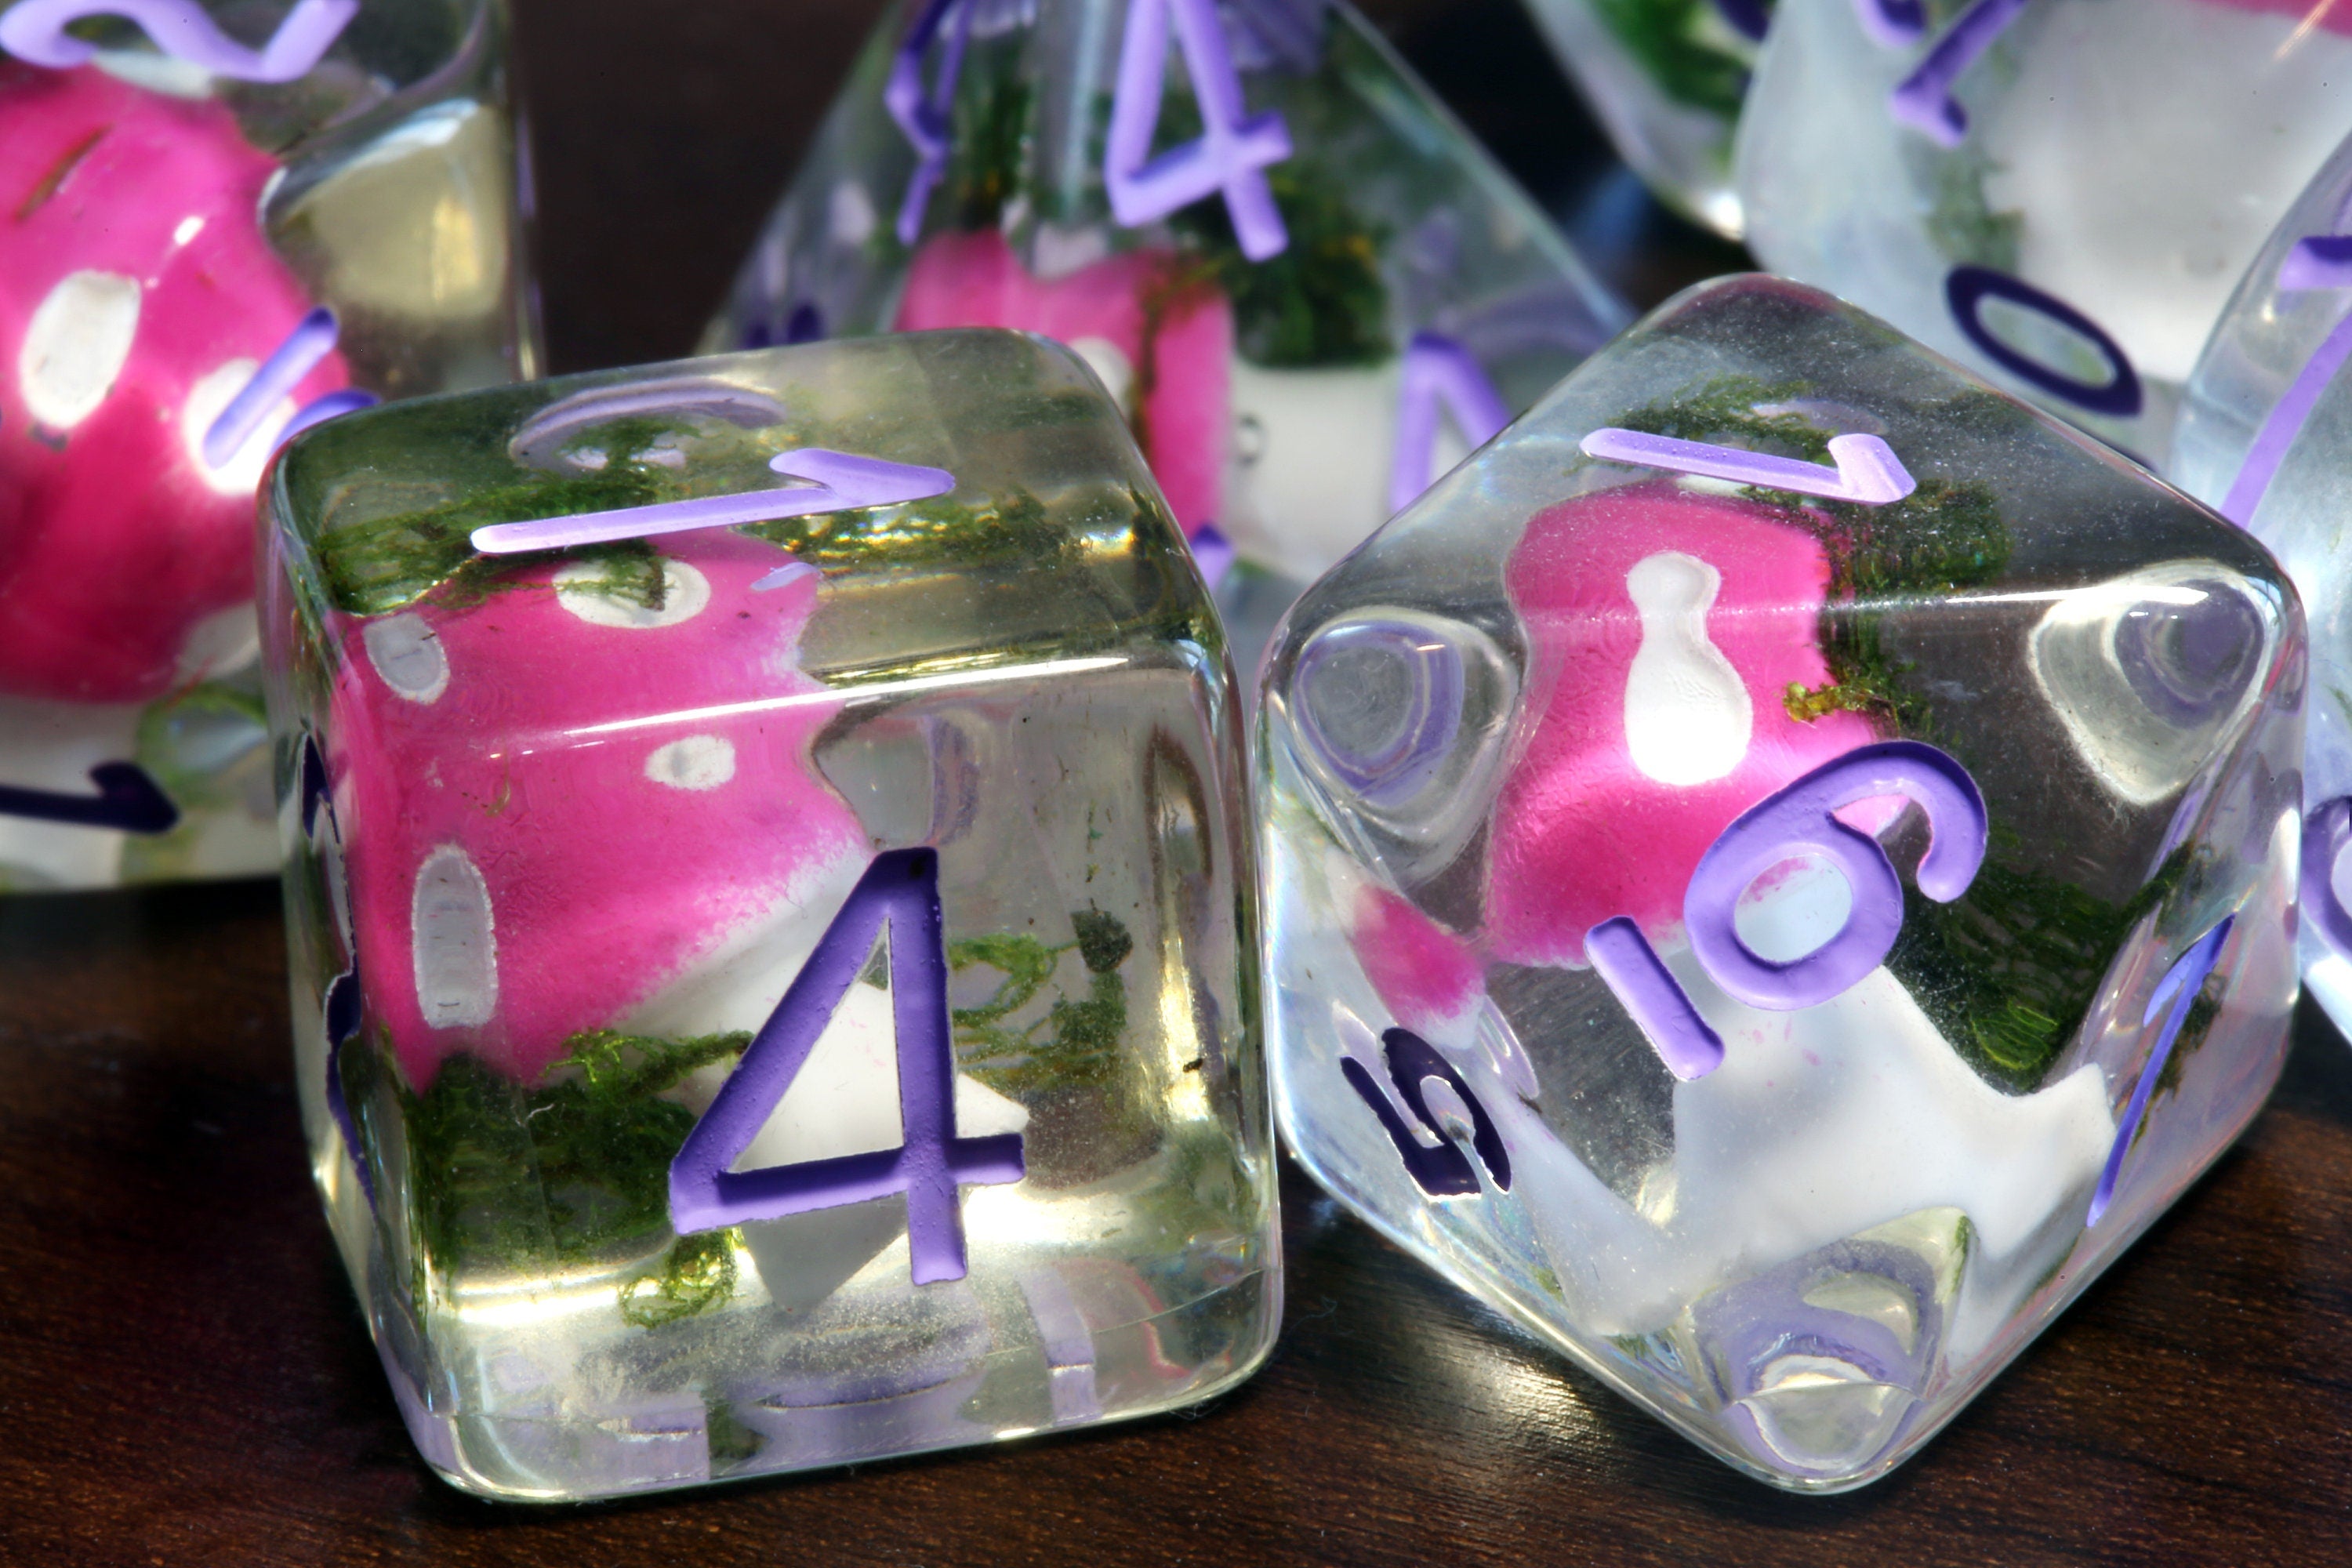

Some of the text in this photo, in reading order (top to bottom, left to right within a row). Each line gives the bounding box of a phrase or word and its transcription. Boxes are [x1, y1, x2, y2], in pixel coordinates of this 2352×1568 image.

[1105, 0, 1293, 262] 4
[471, 448, 956, 554] 1
[1579, 427, 1917, 505] 1
[1684, 739, 1988, 1011] 6
[669, 846, 1025, 1286] 4
[1339, 1027, 1512, 1202] 5
